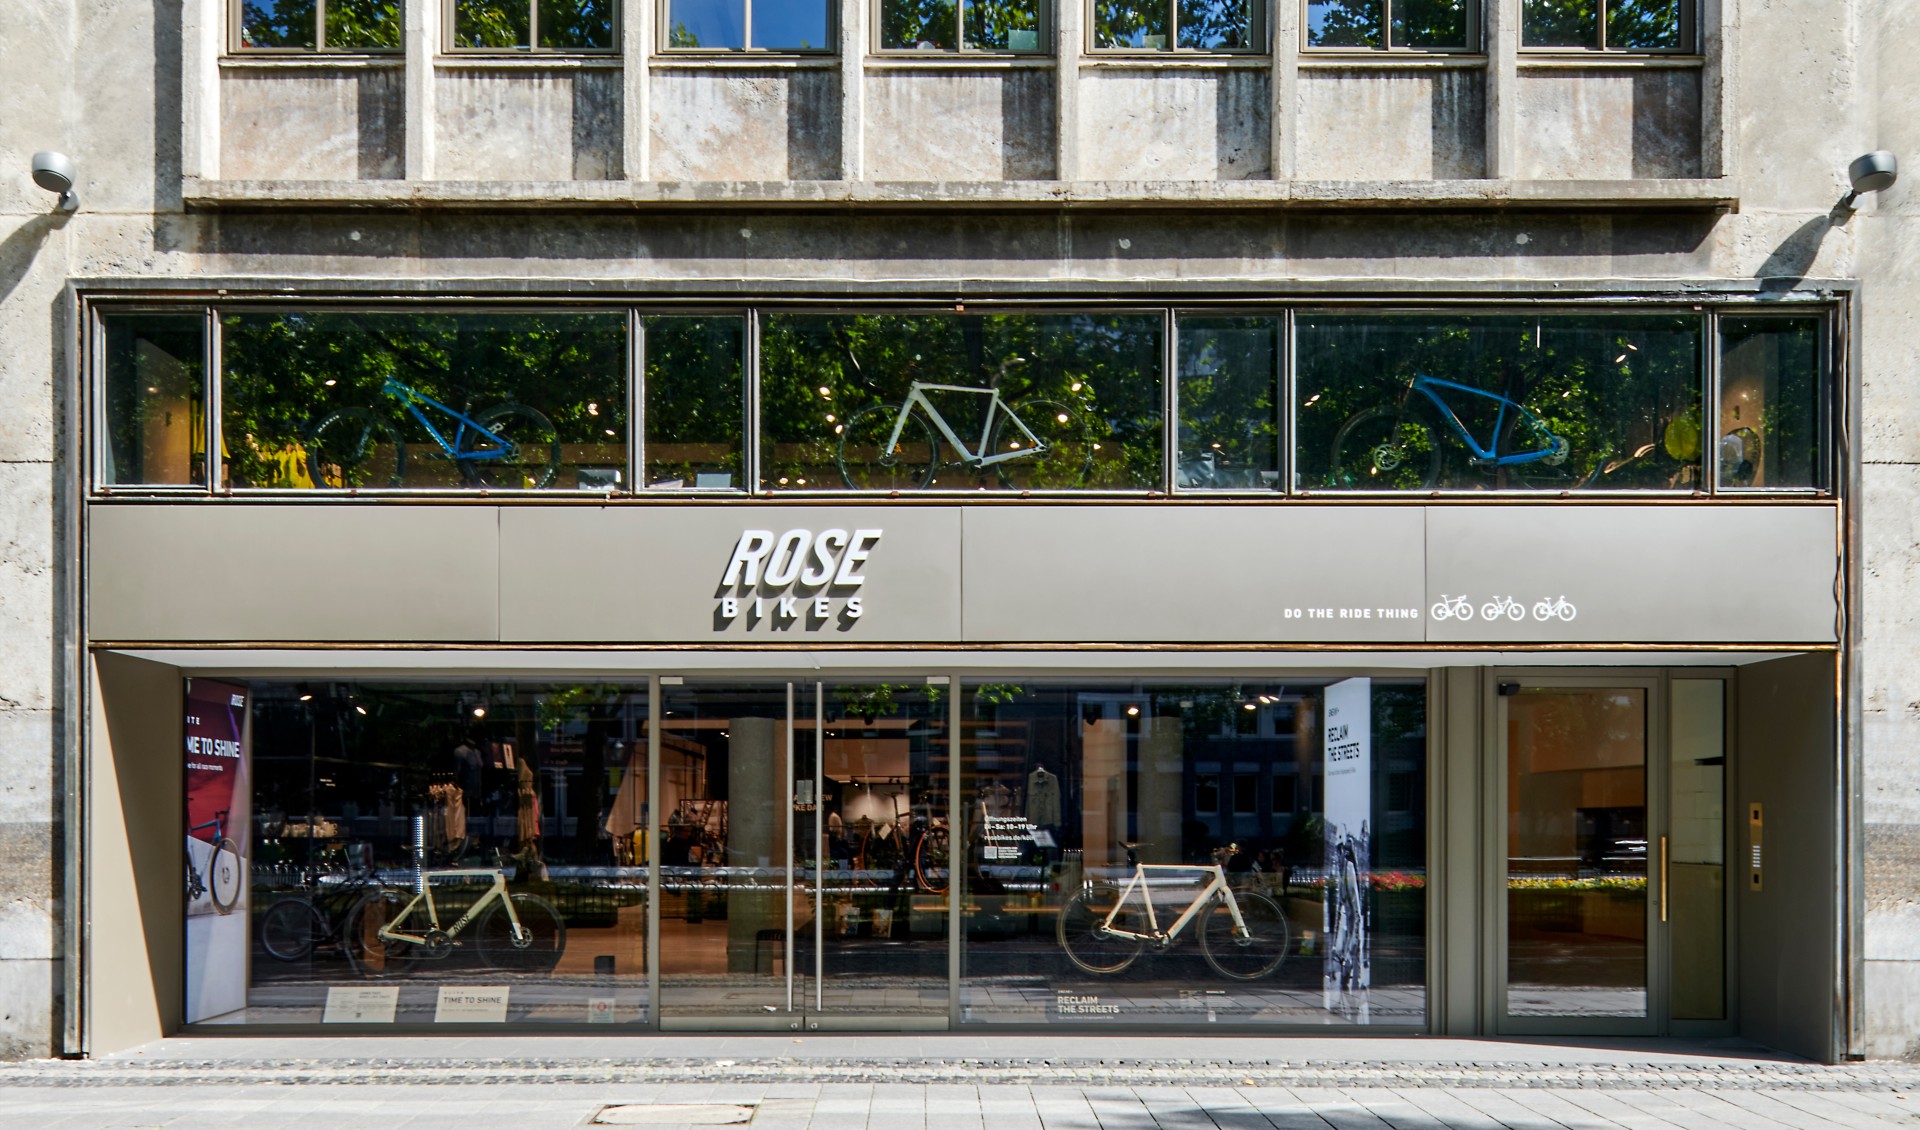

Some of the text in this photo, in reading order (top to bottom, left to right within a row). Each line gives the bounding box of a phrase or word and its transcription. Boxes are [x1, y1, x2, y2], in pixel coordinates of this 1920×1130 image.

[722, 528, 884, 587] ROSE
[722, 597, 864, 618] BIKES
[1284, 608, 1419, 619] DO THE RIDE THING
[1328, 723, 1349, 742] RECLAIM
[201, 737, 213, 755] TO
[214, 739, 240, 758] SHINE
[1338, 742, 1360, 761] STREETS
[1057, 996, 1098, 1004] RECLAIM
[1058, 1005, 1120, 1013] THE STREETS
